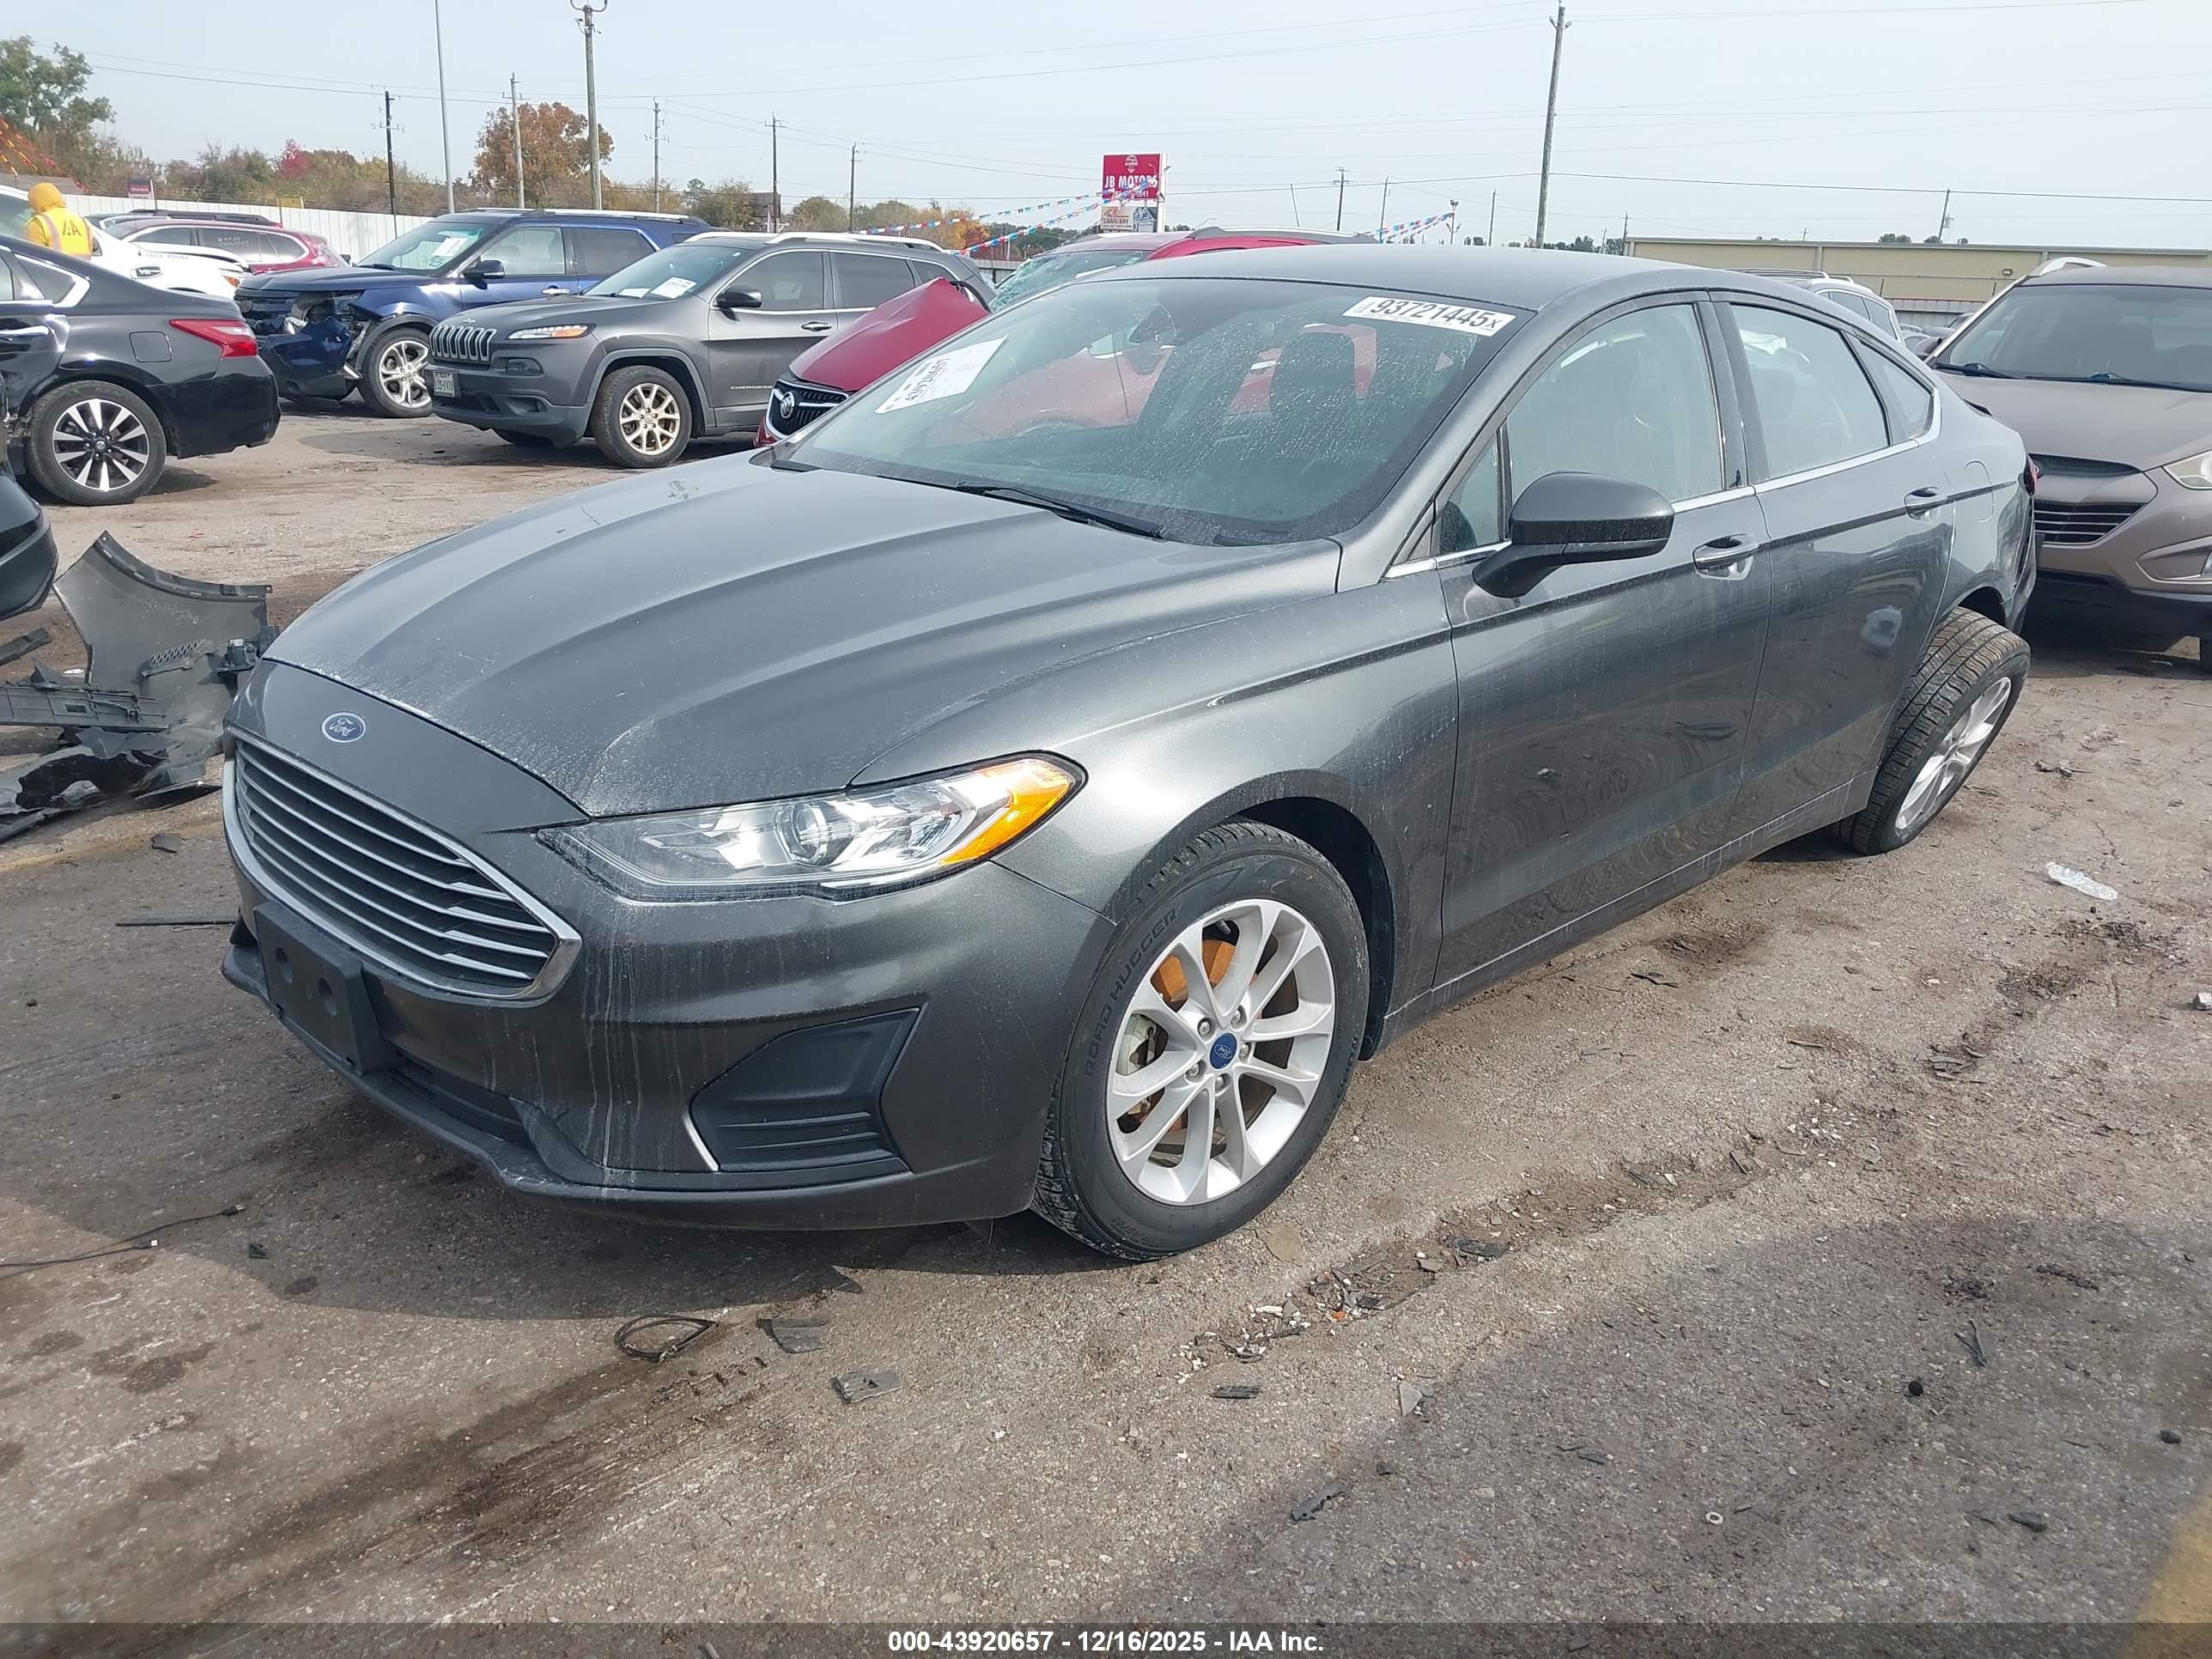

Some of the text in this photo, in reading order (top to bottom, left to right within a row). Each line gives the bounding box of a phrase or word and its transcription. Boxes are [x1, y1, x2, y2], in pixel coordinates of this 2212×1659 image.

[1104, 175, 1115, 188] JB
[328, 717, 356, 737] Ford
[1085, 906, 1177, 1078] ROAD HUGGER
